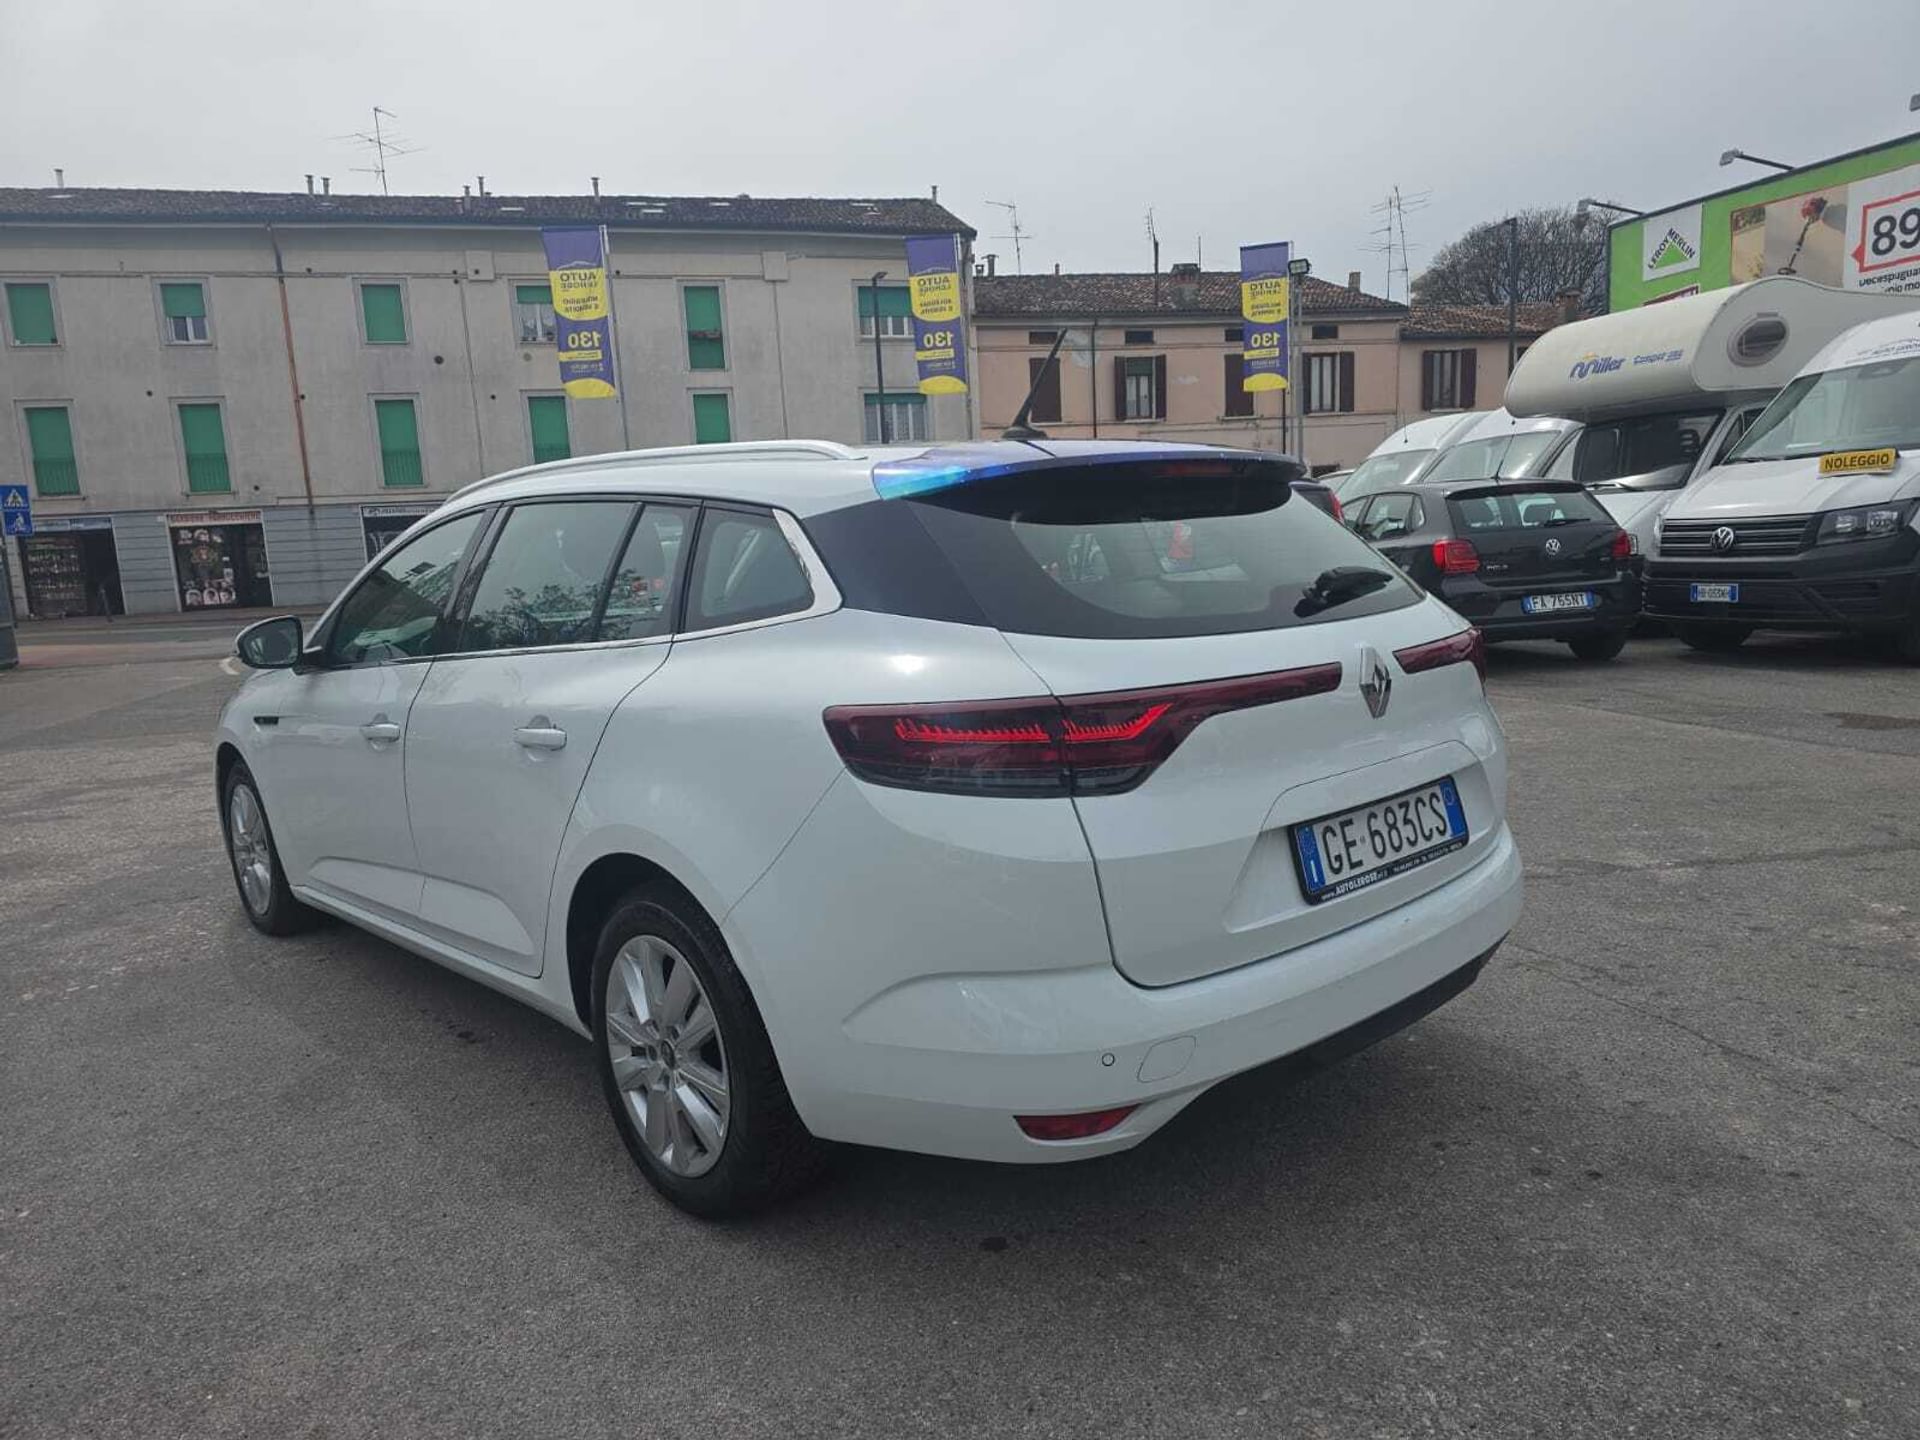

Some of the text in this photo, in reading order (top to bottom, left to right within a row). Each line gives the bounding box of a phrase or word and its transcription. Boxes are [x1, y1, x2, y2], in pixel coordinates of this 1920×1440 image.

[1648, 228, 1696, 269] LEROY MERLIN
[1871, 207, 1920, 256] 89
[1825, 453, 1889, 469] NOLEGGIO
[1322, 818, 1363, 875] GE
[1367, 792, 1447, 859] 683CS
